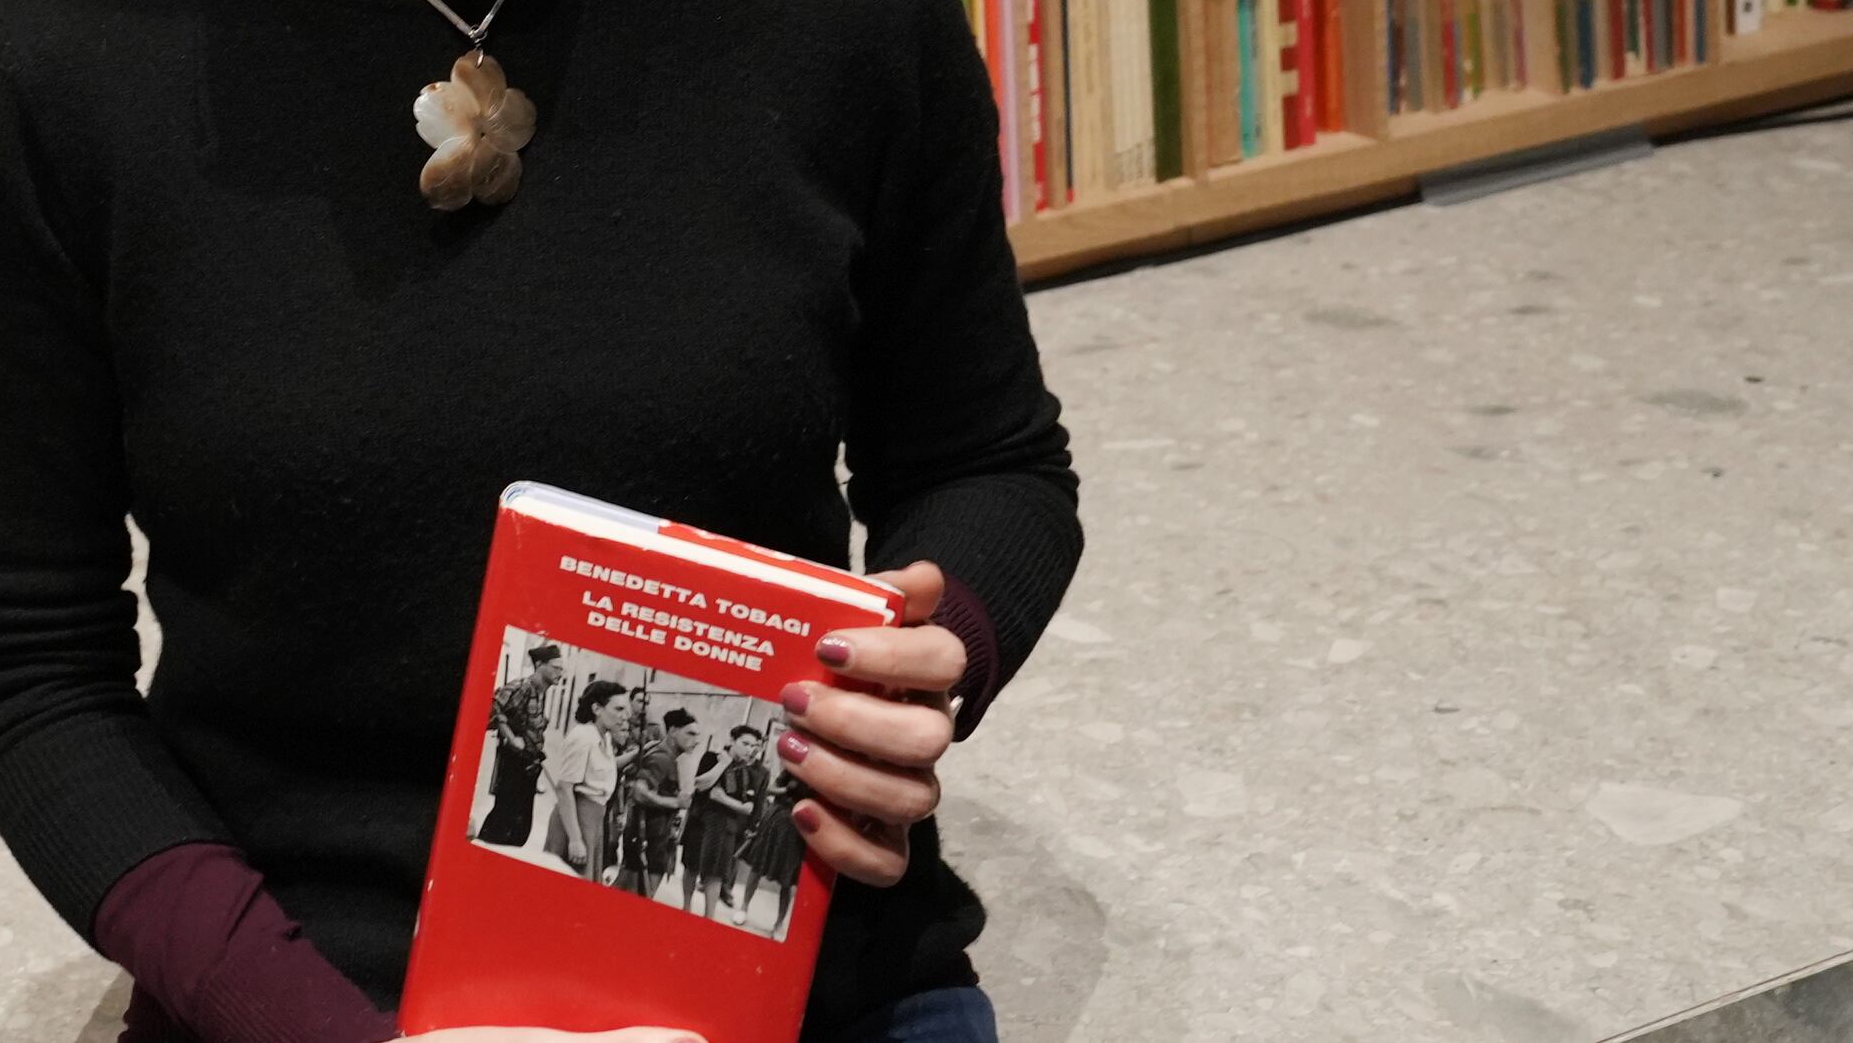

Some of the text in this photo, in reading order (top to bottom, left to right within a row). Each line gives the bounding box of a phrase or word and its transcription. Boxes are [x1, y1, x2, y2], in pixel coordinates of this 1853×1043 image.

[558, 555, 812, 638] BENEDETTA TOBAGI
[581, 590, 776, 657] LA RESISTENZA
[586, 610, 764, 672] DELLE DONNE
